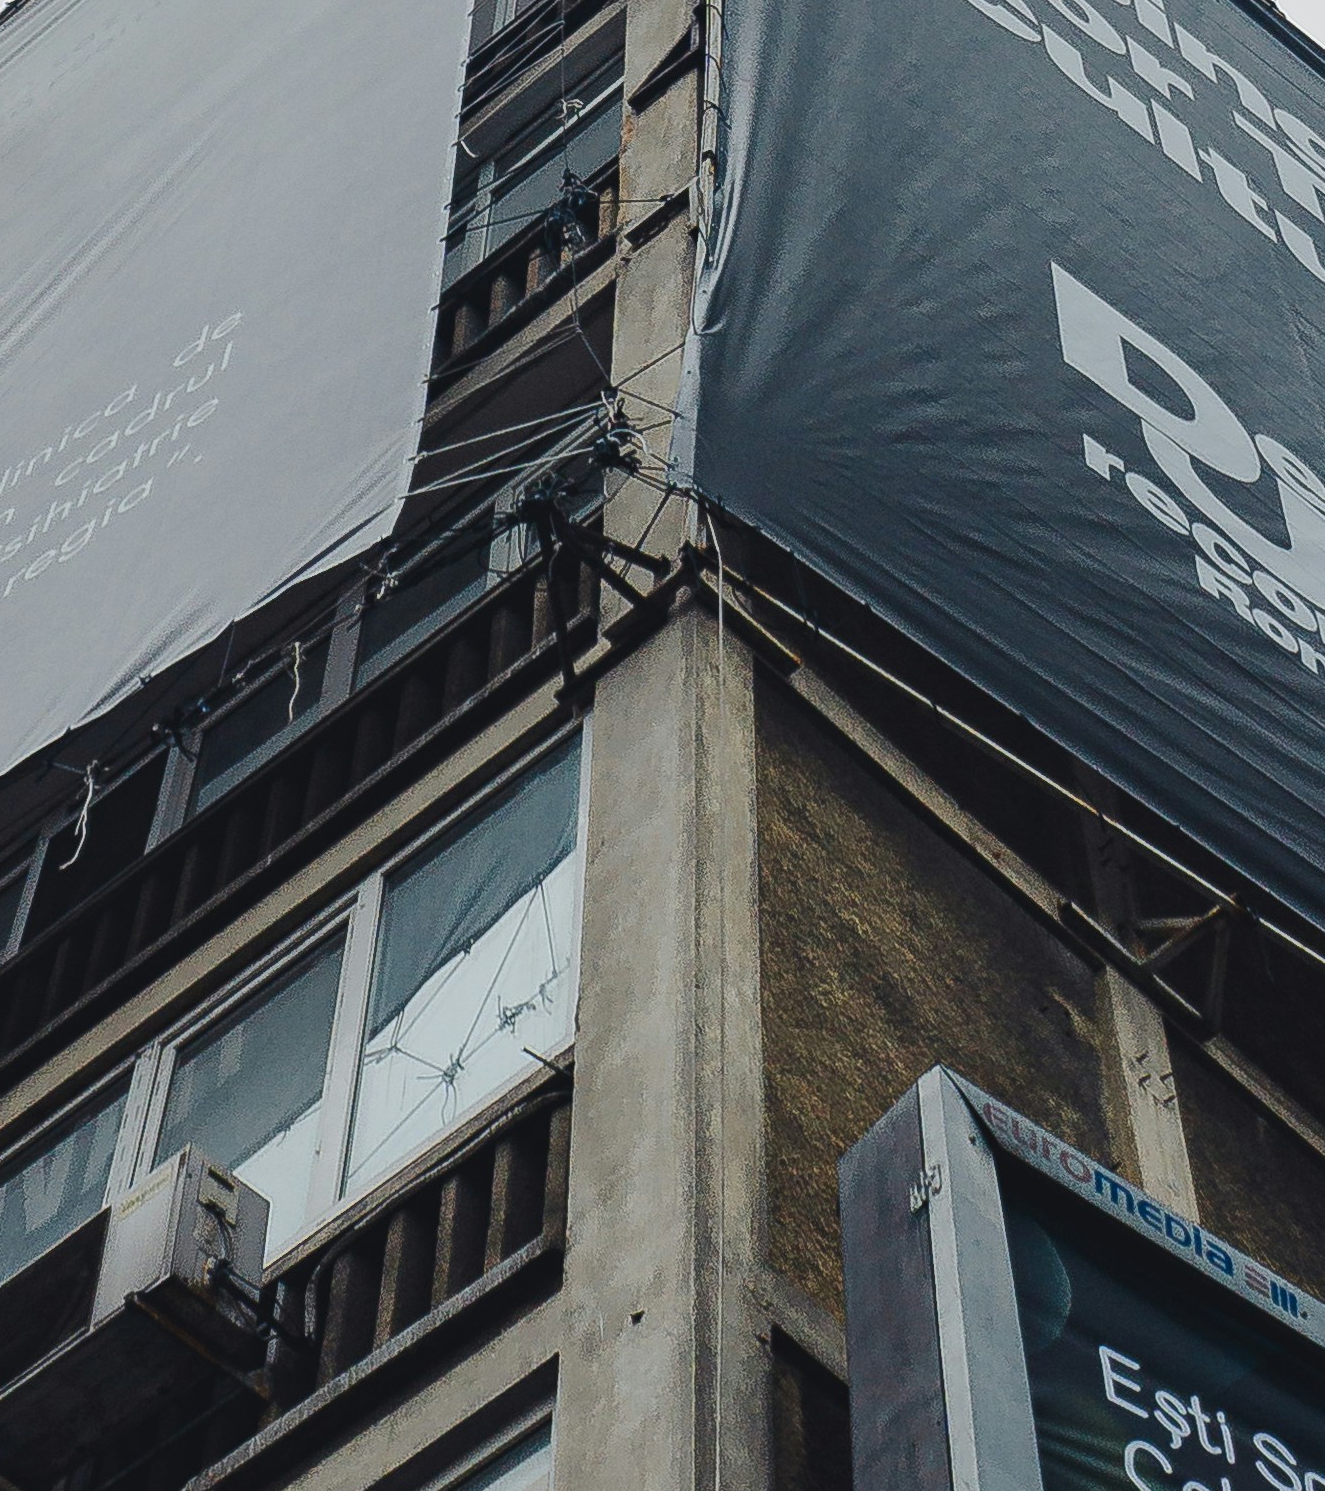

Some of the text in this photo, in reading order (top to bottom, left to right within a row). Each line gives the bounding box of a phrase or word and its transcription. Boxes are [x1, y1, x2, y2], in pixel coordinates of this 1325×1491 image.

[172, 311, 242, 367] de
[53, 340, 233, 486] cadrul
[1099, 1346, 1235, 1464] Ești
